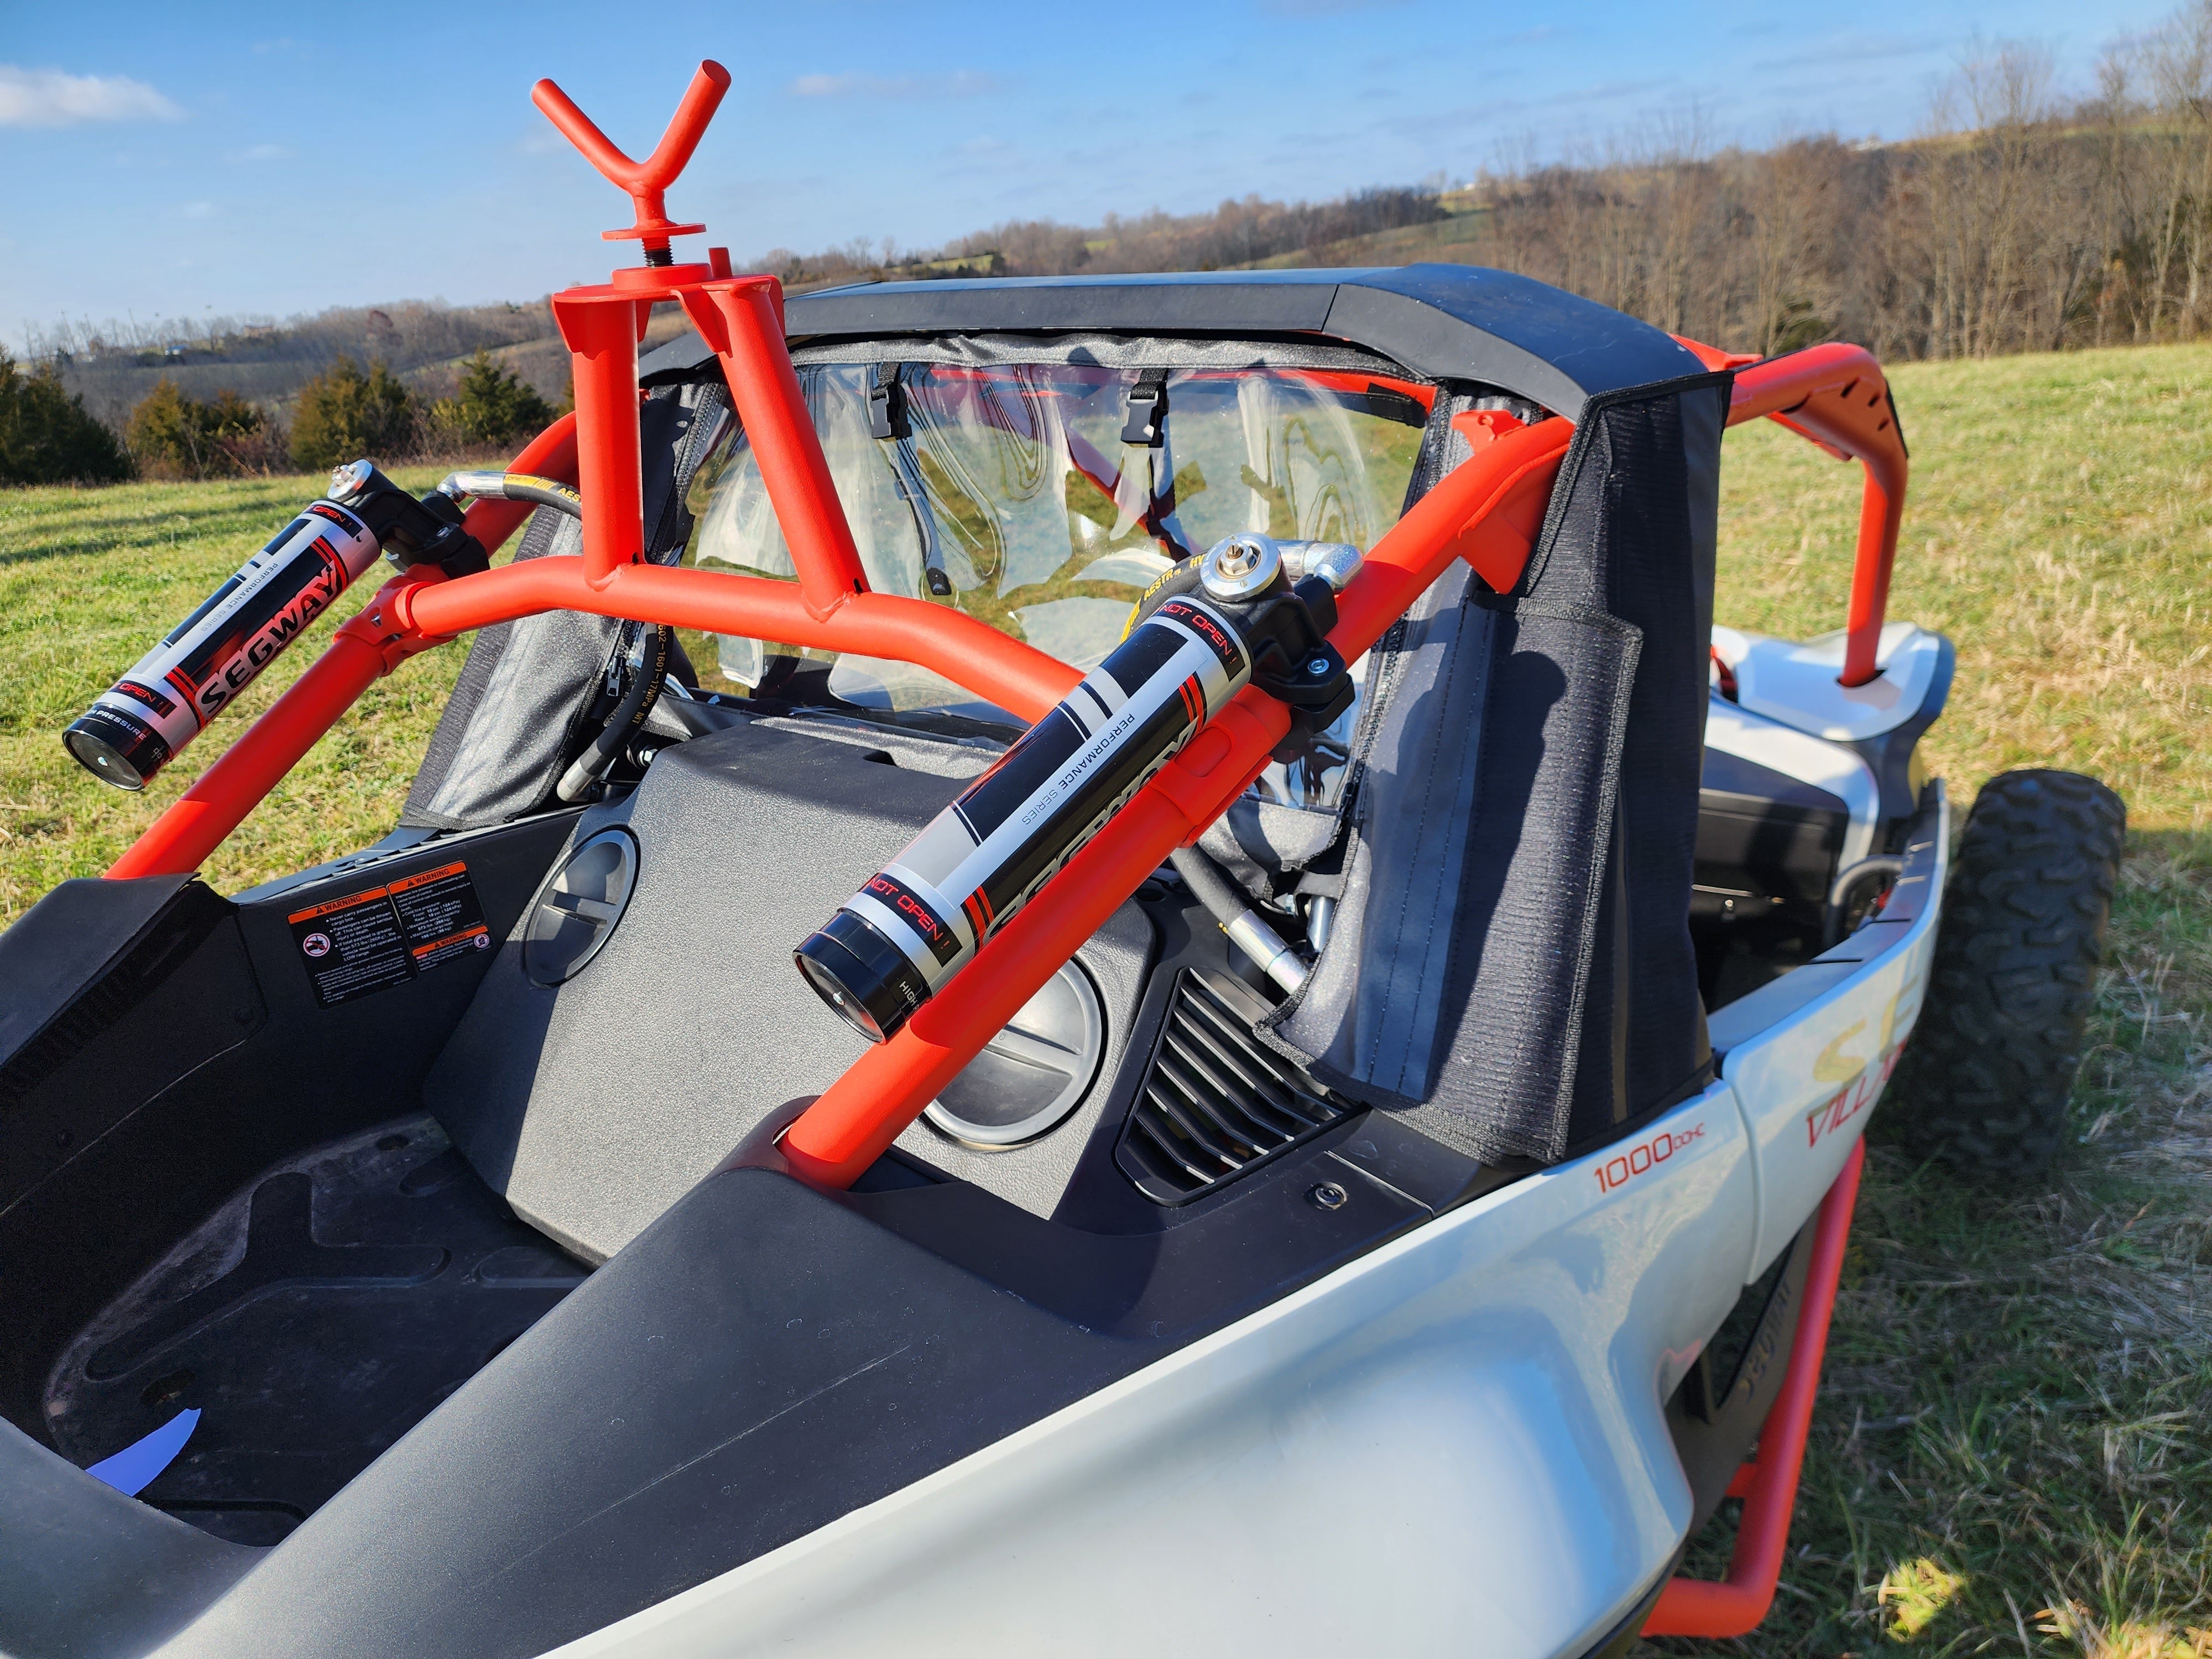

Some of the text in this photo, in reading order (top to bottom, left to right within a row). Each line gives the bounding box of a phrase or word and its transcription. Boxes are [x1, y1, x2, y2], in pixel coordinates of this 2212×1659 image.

[313, 505, 346, 522] OPEN
[201, 563, 278, 632] PERFORMANCE SERIES
[199, 562, 336, 714] SEGWAY
[1159, 604, 1192, 615] NOT
[1192, 614, 1233, 656] OPEN
[119, 683, 157, 703] OPEN
[96, 710, 147, 740] PRESSURE
[1022, 713, 1135, 825] PERFORMANCE SERIES
[415, 868, 450, 884] WARNING
[325, 895, 362, 911] WARNING
[897, 895, 943, 941] OPEN
[440, 933, 467, 945] WARNING
[899, 980, 918, 1006] HIGH
[1594, 1132, 1673, 1193] 1000
